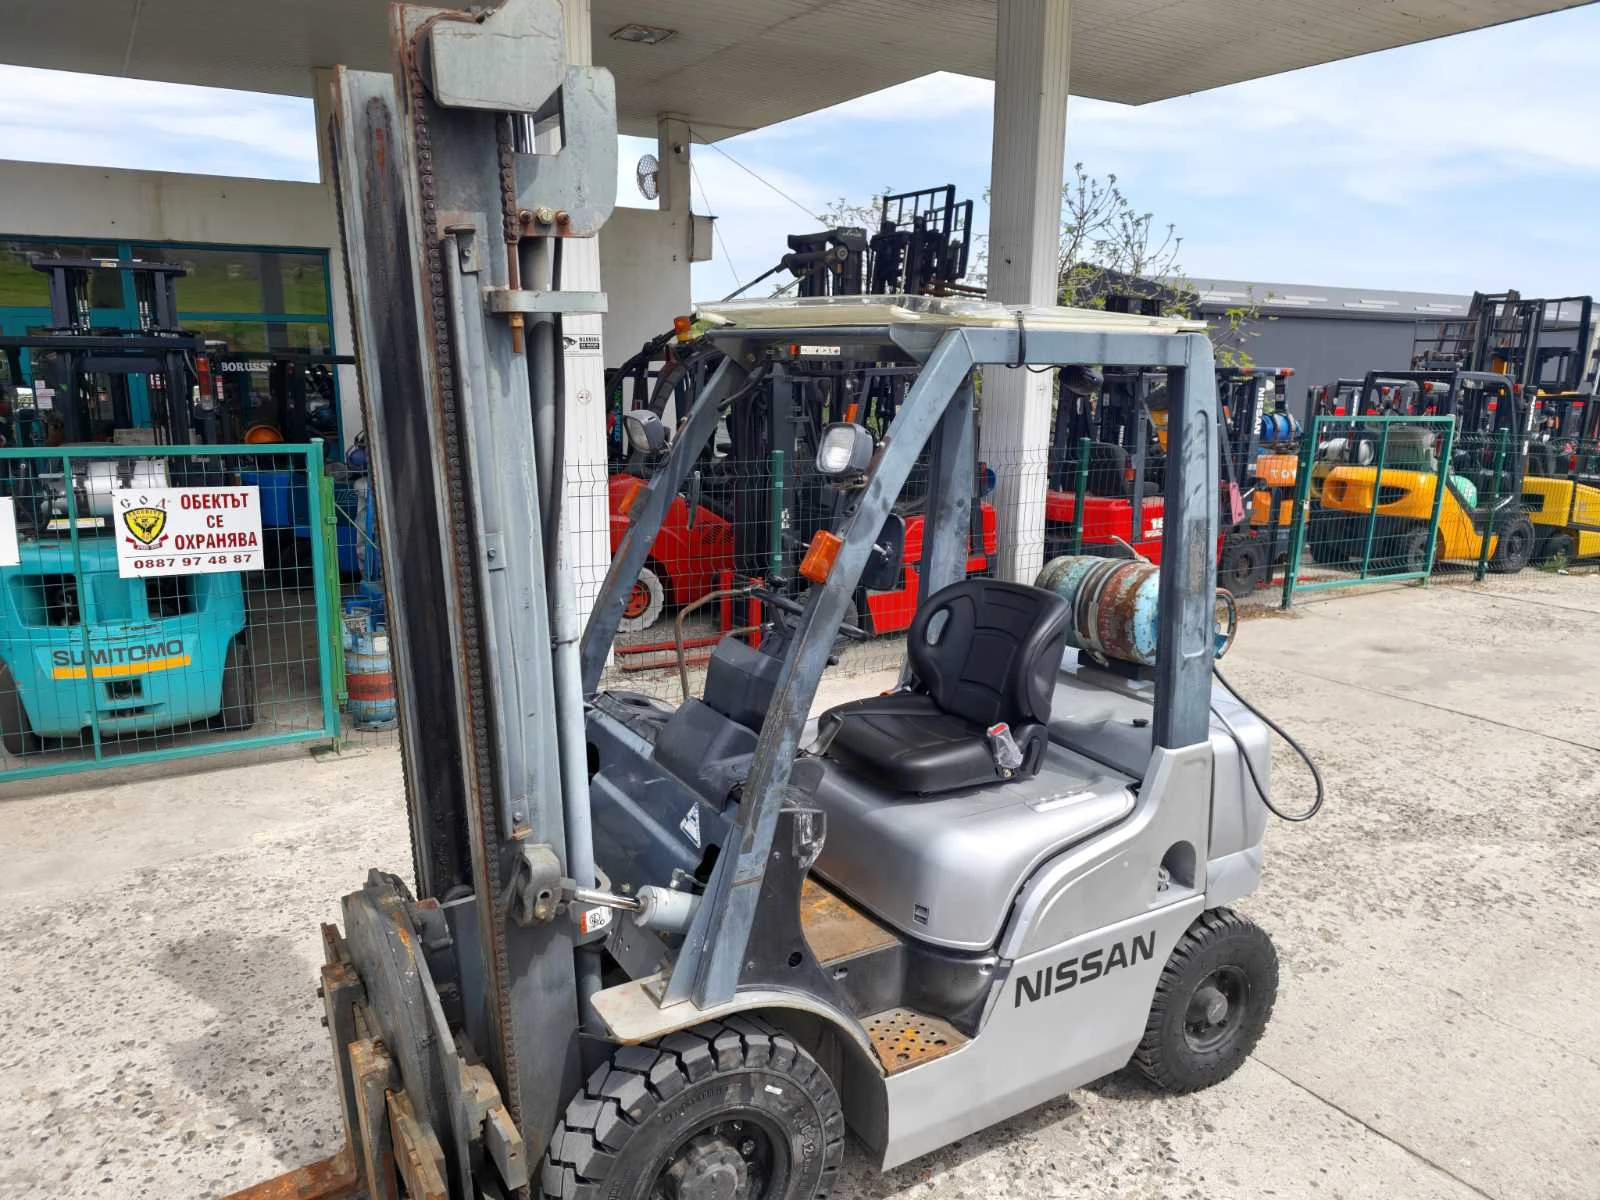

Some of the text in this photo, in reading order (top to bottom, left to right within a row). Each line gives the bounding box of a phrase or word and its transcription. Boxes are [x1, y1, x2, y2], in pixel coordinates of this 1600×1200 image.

[1253, 387, 1266, 435] NISSAN
[180, 492, 249, 510] ОБЕКТЪТ
[206, 514, 224, 529] СЕ
[174, 531, 258, 550] ОХРАНЯВА
[133, 554, 252, 569] 0887 97 48 87
[52, 639, 184, 666] SUMITOMO
[1014, 930, 1156, 1008] NISSAN
